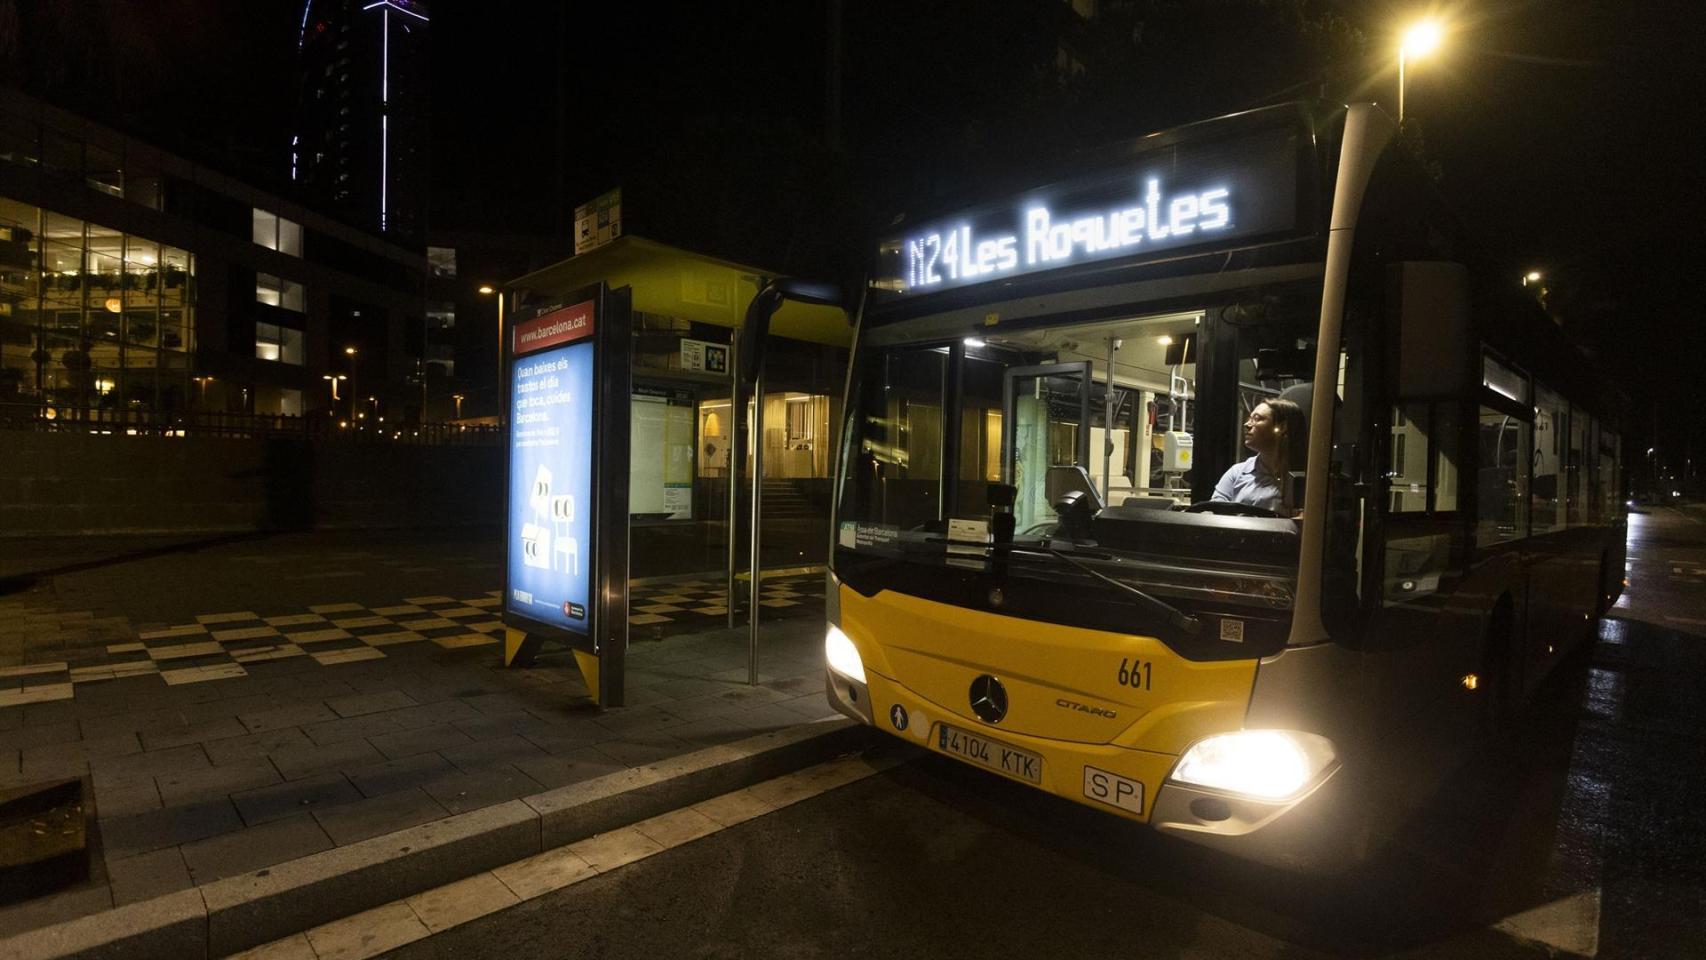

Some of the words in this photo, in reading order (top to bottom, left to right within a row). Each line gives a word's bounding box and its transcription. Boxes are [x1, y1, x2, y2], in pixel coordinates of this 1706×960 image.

[911, 229, 957, 287] N24
[962, 226, 1016, 277] Les
[1028, 179, 1230, 265] Roquetes
[520, 314, 587, 344] www.barcelona.cat
[517, 366, 534, 379] Quan
[534, 361, 556, 375] baixes
[1118, 658, 1152, 691] 661
[1056, 699, 1117, 719] CITARO
[950, 732, 989, 762] 4104
[1002, 748, 1034, 778] KTK
